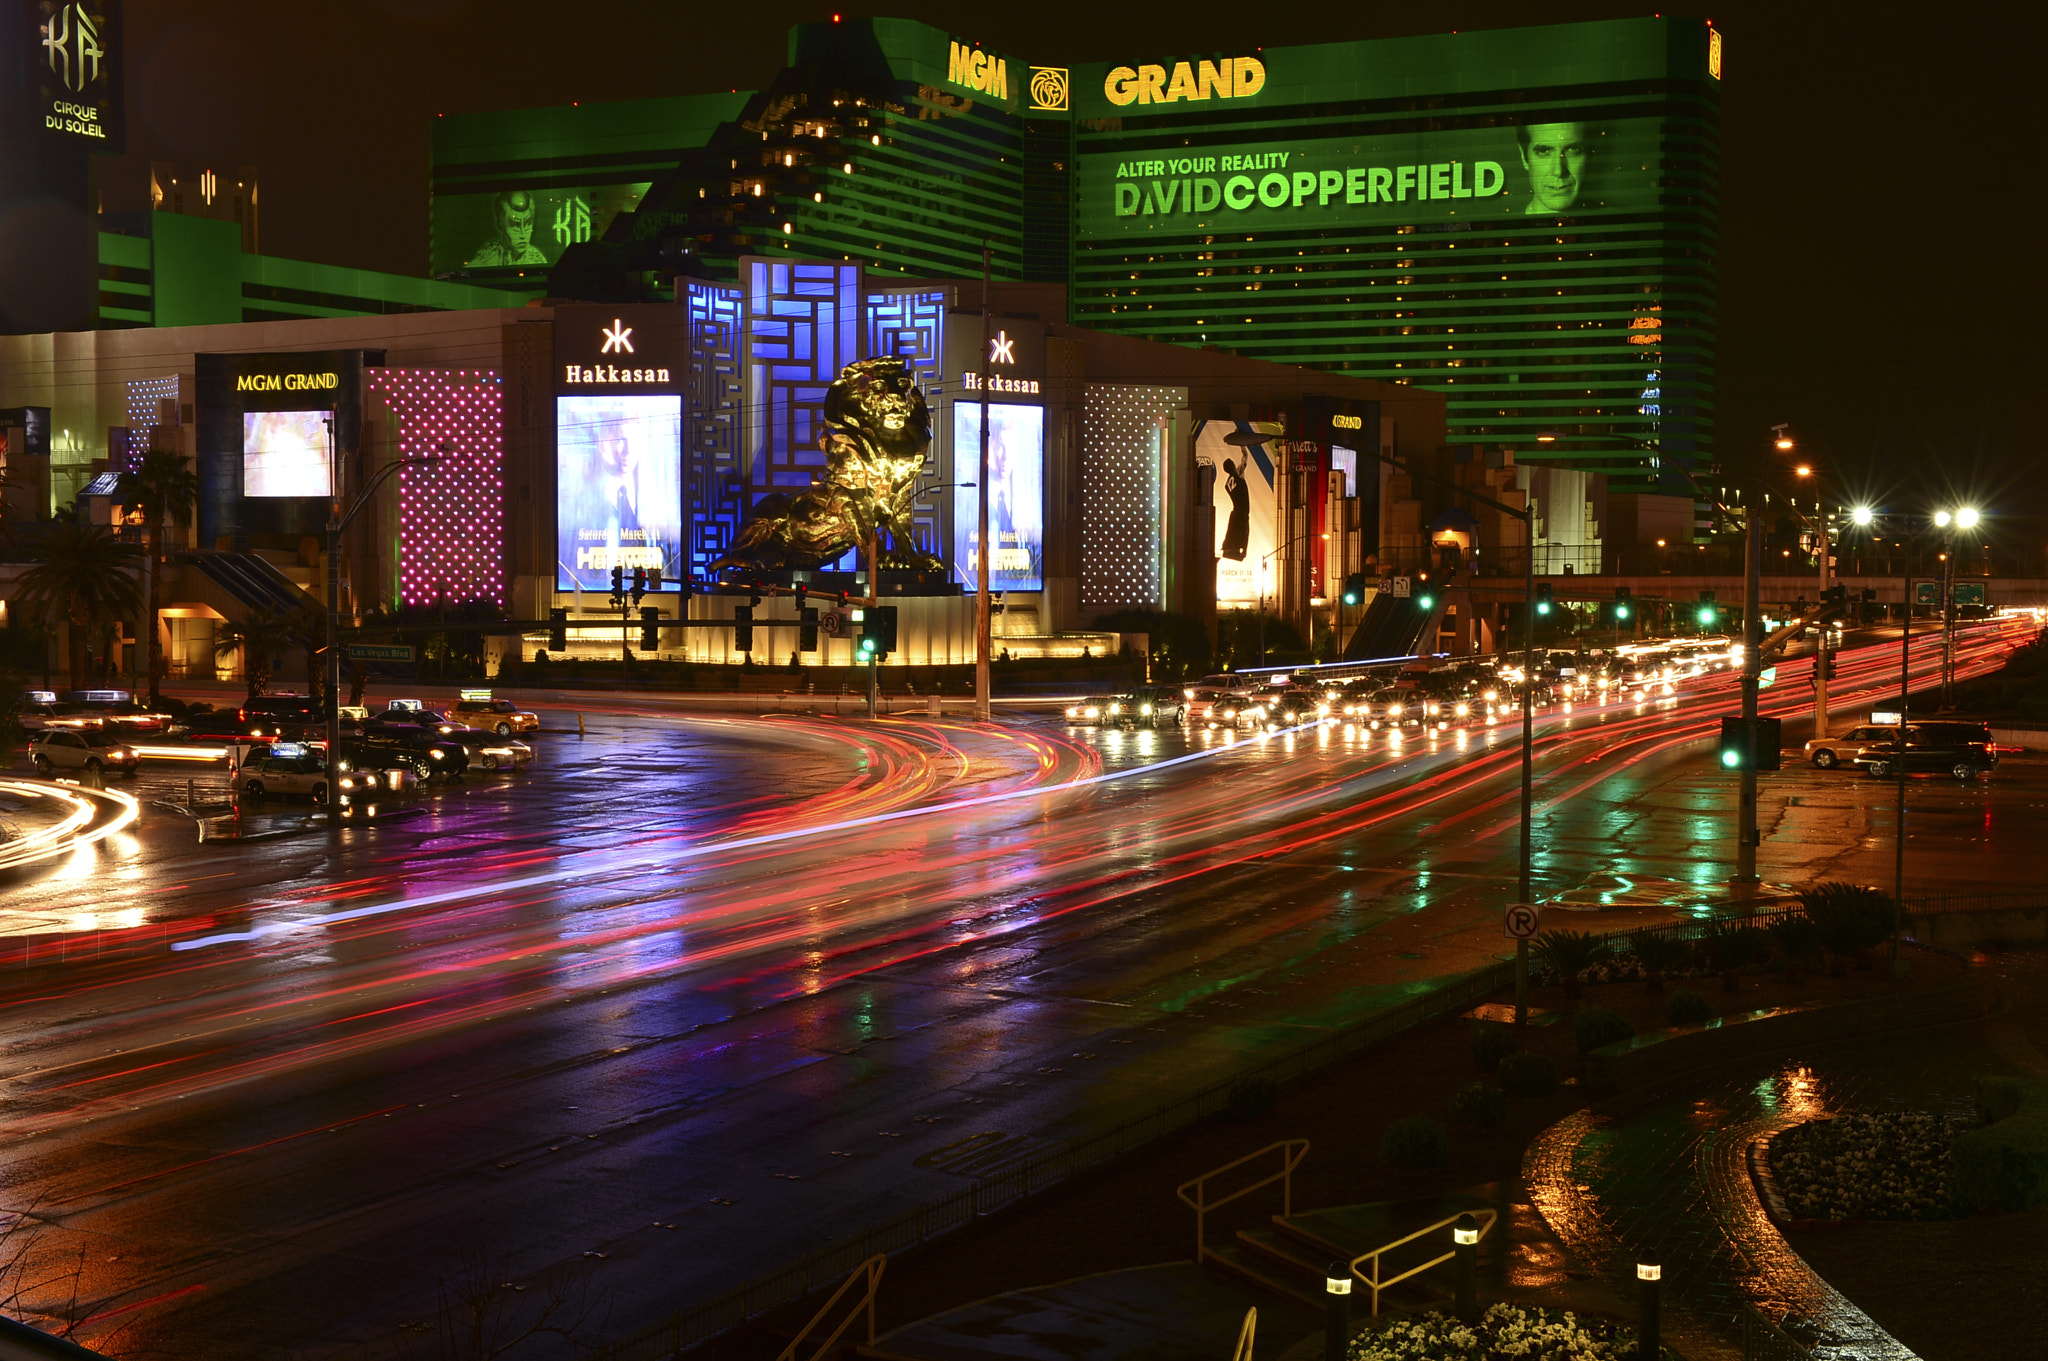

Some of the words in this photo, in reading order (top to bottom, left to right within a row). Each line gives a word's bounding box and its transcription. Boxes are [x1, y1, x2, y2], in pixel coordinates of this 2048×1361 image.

[948, 40, 1008, 101] MGM
[1104, 56, 1266, 106] GRAND
[53, 100, 98, 122] CIRQUE
[45, 115, 63, 130] DU
[65, 119, 106, 138] SOLEIL
[1116, 160, 1165, 178] ALTER
[1168, 156, 1216, 175] YOUR
[1221, 152, 1291, 171] REALITY
[236, 374, 281, 391] MGM
[284, 372, 339, 390] GRAND
[565, 364, 670, 383] Hakkasan
[963, 371, 1040, 394] Hakkasan
[351, 647, 366, 657] Las
[366, 648, 390, 659] Vegas
[391, 649, 409, 658] Blvd
